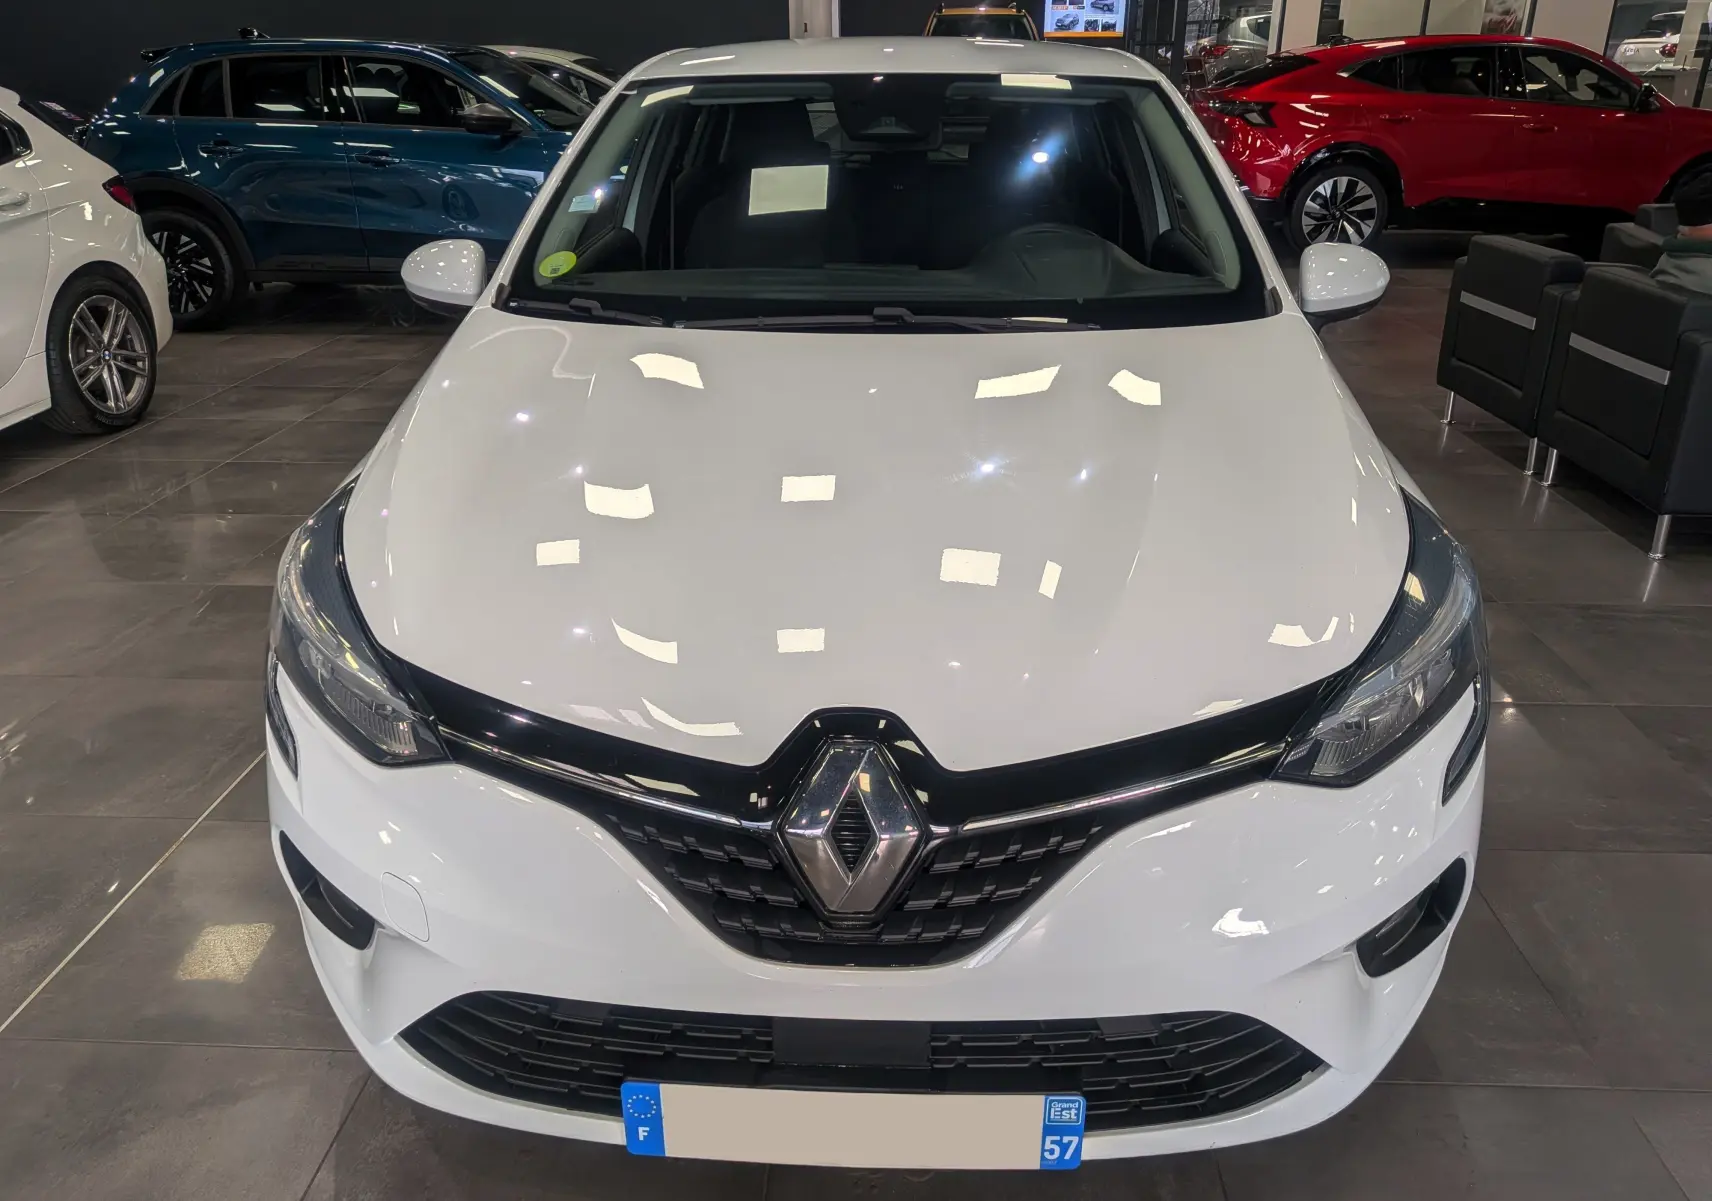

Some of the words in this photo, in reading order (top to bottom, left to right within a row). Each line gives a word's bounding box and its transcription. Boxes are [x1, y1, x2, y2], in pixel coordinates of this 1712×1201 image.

[1050, 1108, 1078, 1119] Est
[638, 1126, 650, 1141] F
[1043, 1136, 1080, 1160] 57
